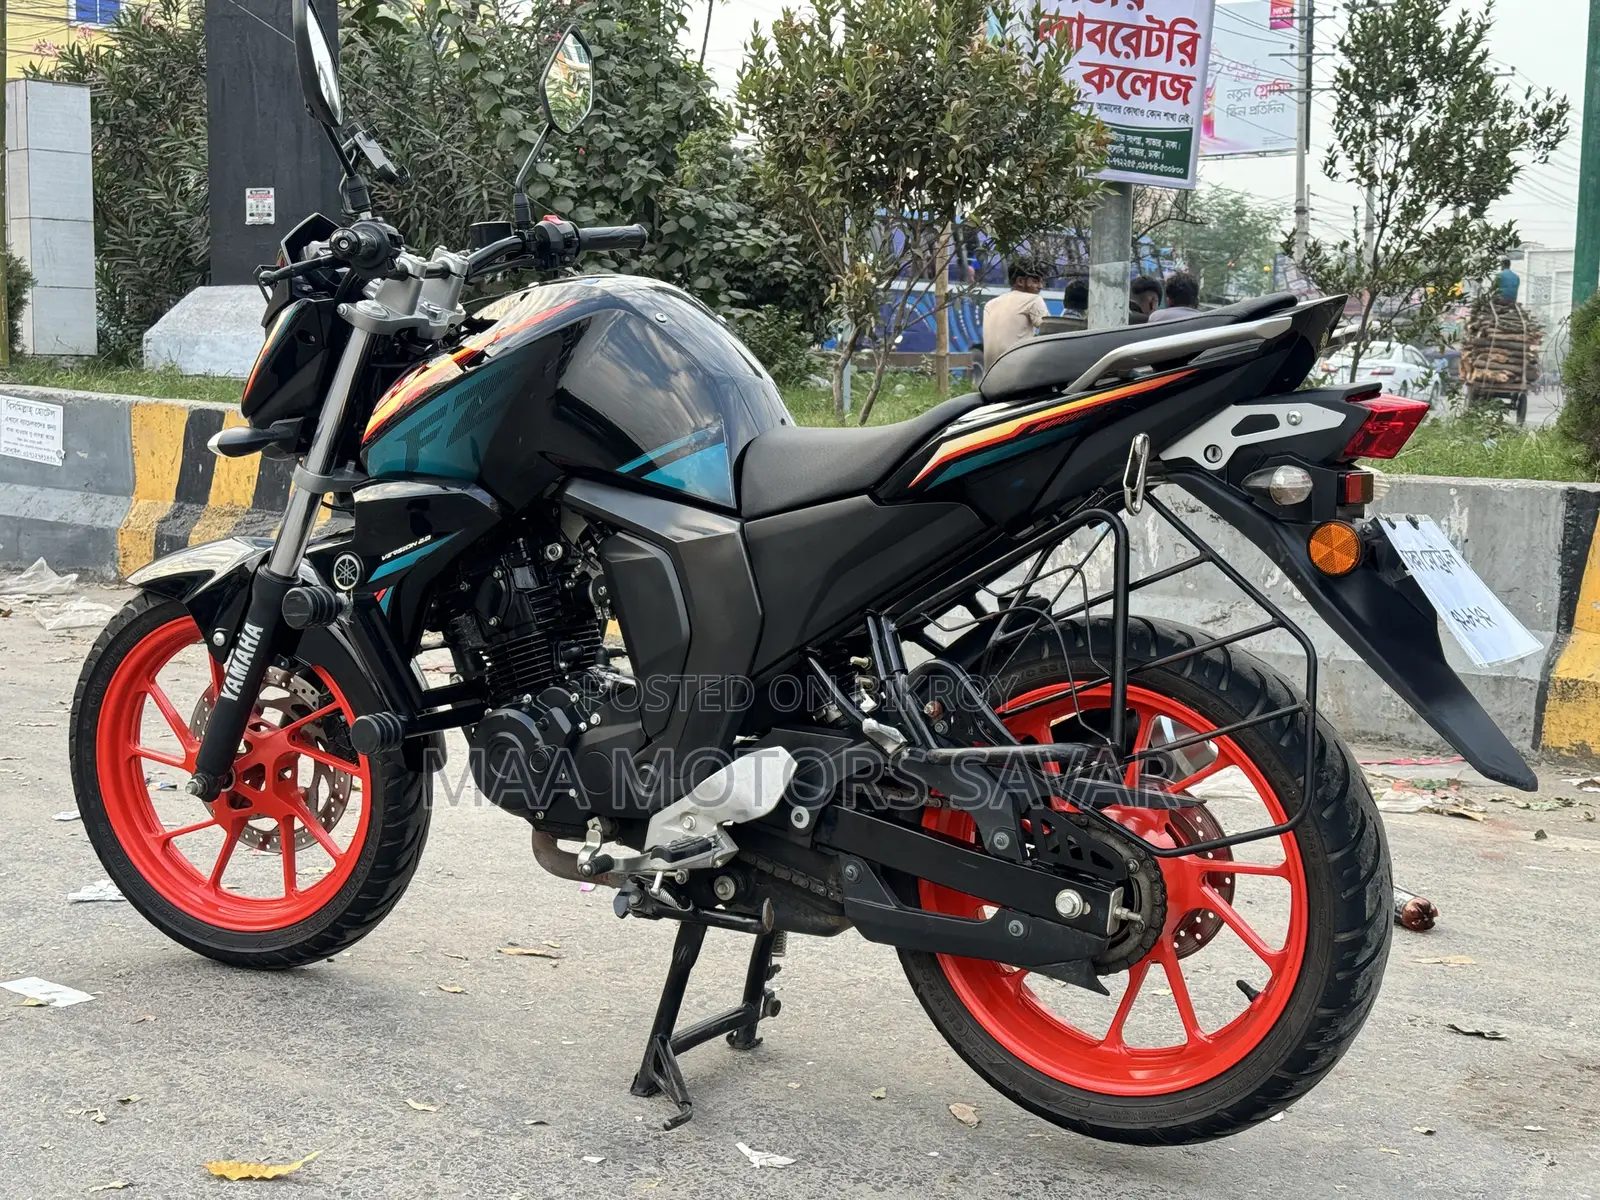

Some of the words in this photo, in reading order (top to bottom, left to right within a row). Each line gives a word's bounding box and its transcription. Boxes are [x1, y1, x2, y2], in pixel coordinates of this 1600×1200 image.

[1079, 61, 1197, 106] কলেজ
[1226, 87, 1252, 102] নতুন
[1096, 102, 1122, 114] আমাদের
[1123, 105, 1145, 118] কোথাও
[1146, 108, 1162, 120] কোন
[1163, 110, 1178, 123] শাখা
[1249, 99, 1285, 116] প্রতিদিন
[394, 362, 526, 472] FZ
[221, 621, 265, 702] YAMAHA
